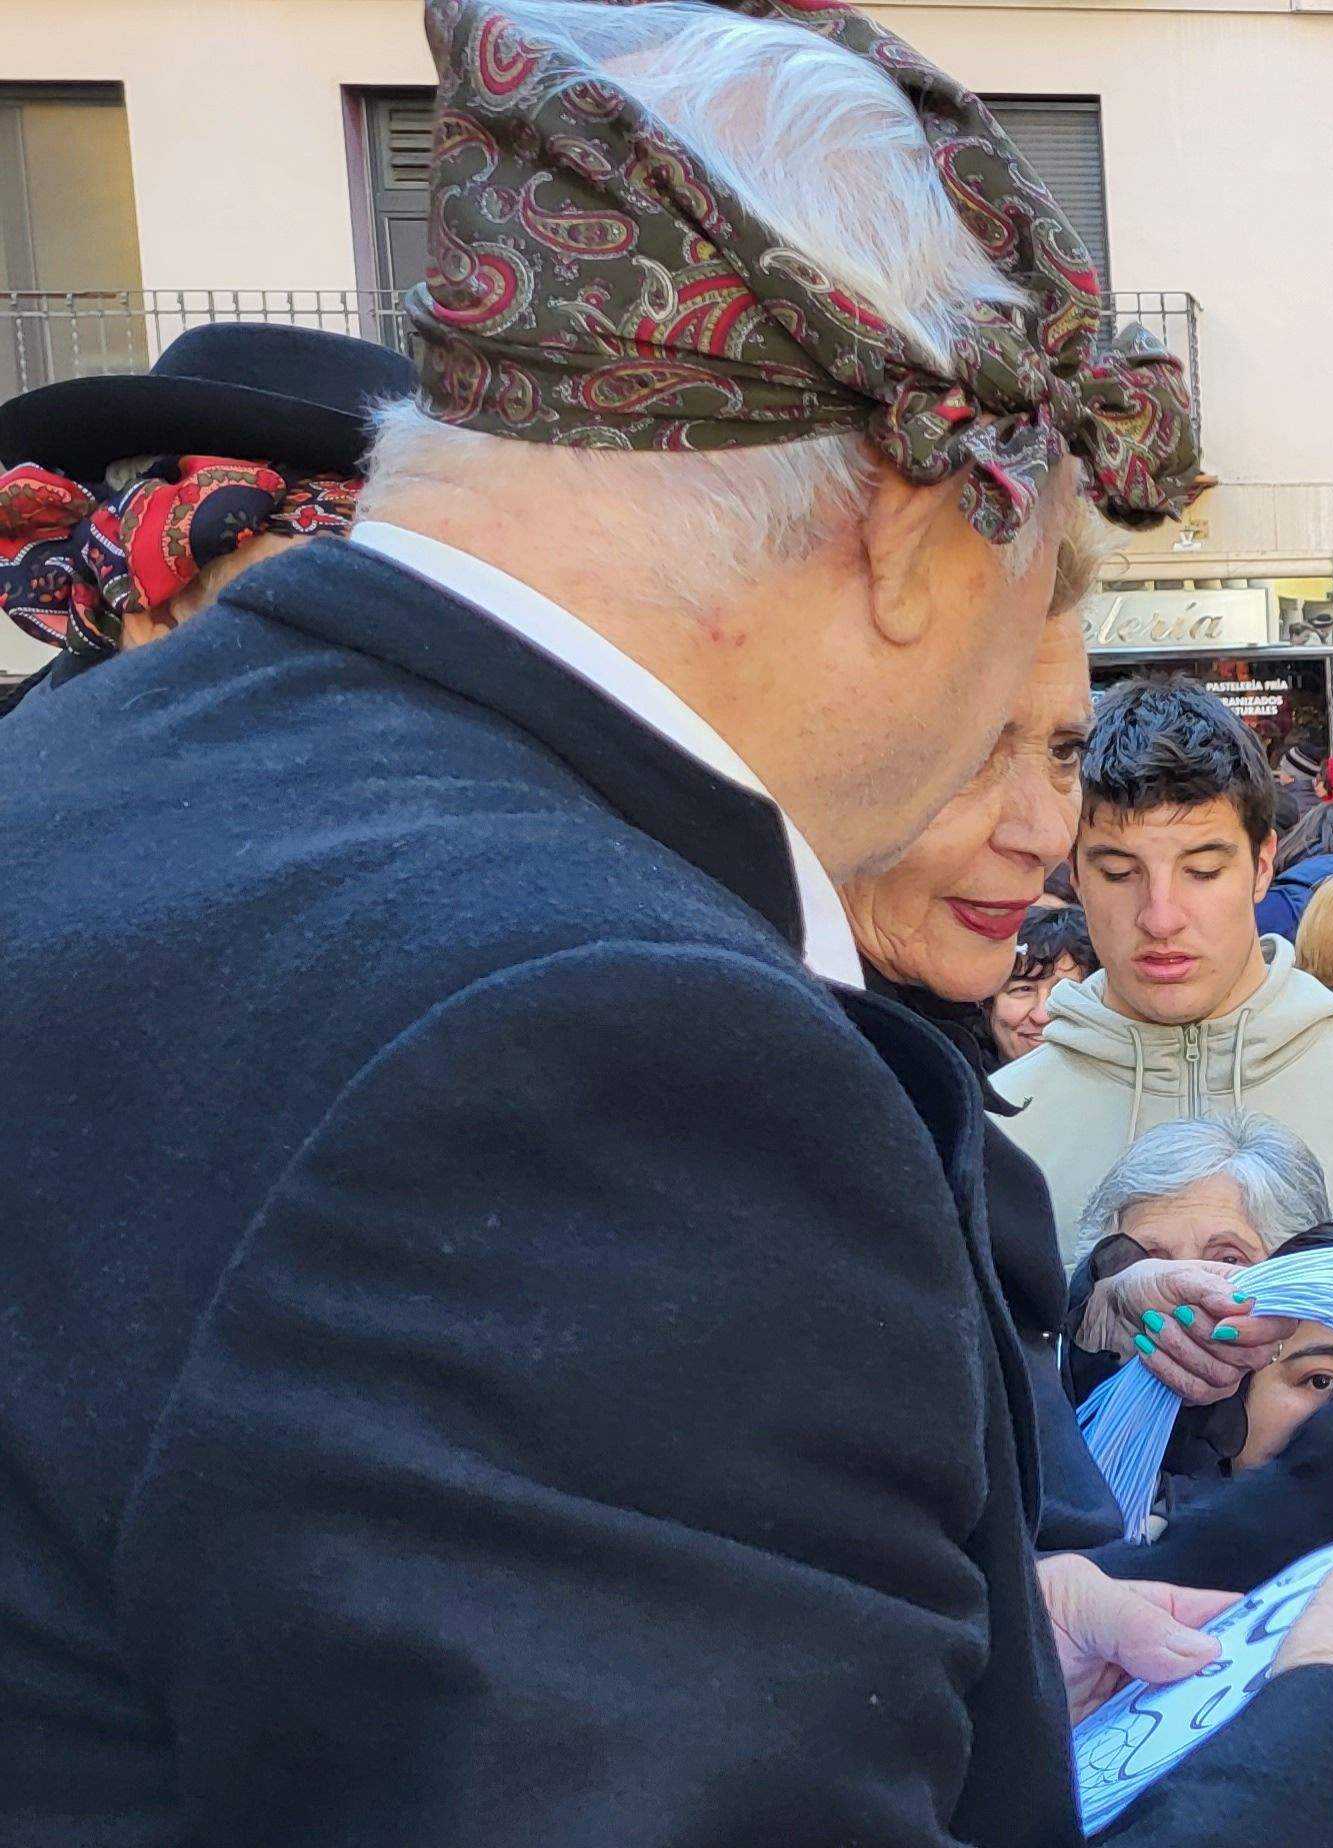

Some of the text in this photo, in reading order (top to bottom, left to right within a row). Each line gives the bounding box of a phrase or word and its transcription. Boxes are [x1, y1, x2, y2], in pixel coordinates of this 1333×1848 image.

[1206, 678, 1289, 692] PASTELERÍA FRÍA
[1221, 695, 1284, 706] RANIZADOS
[1231, 706, 1279, 717] TURALES
